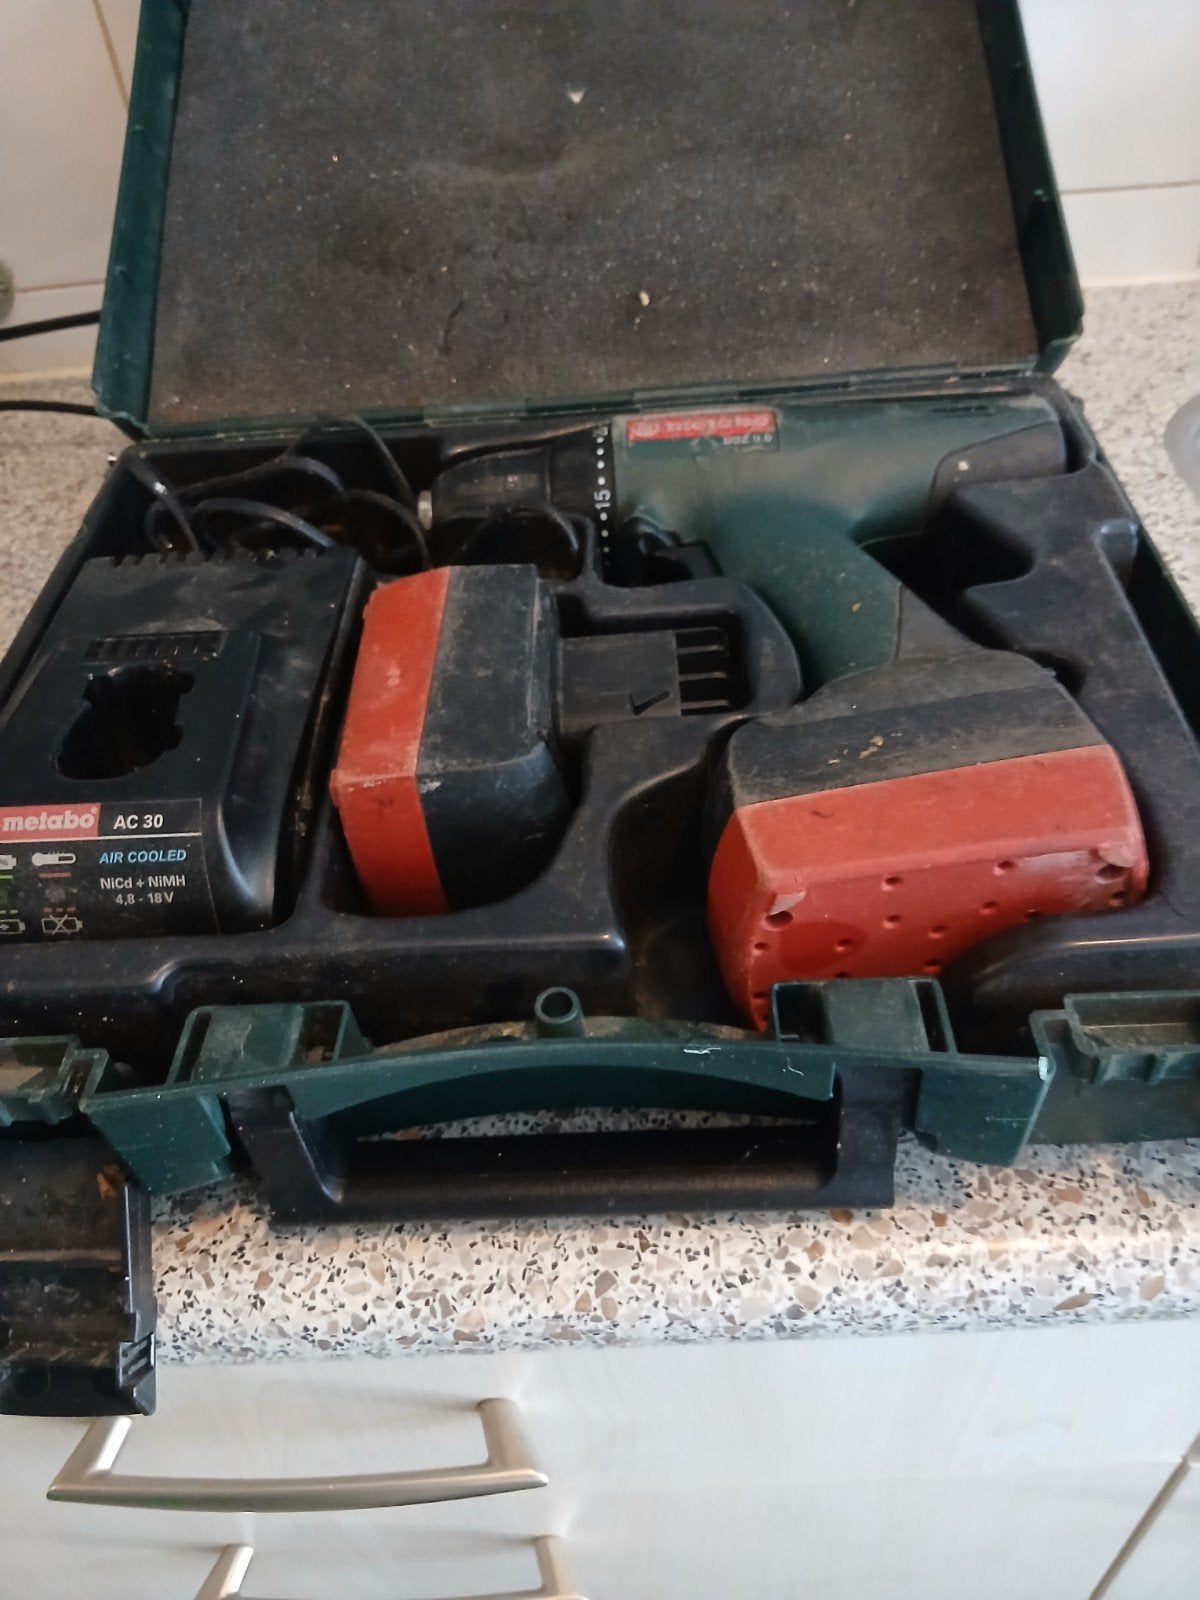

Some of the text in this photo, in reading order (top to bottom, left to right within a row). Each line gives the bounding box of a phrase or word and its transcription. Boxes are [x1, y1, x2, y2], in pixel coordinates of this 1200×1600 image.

[594, 489, 611, 510] 15
[2, 809, 95, 832] metabo
[113, 813, 164, 831] AC 30
[99, 848, 187, 865] AIR COOLED
[100, 874, 186, 890] NiCd + NiMH
